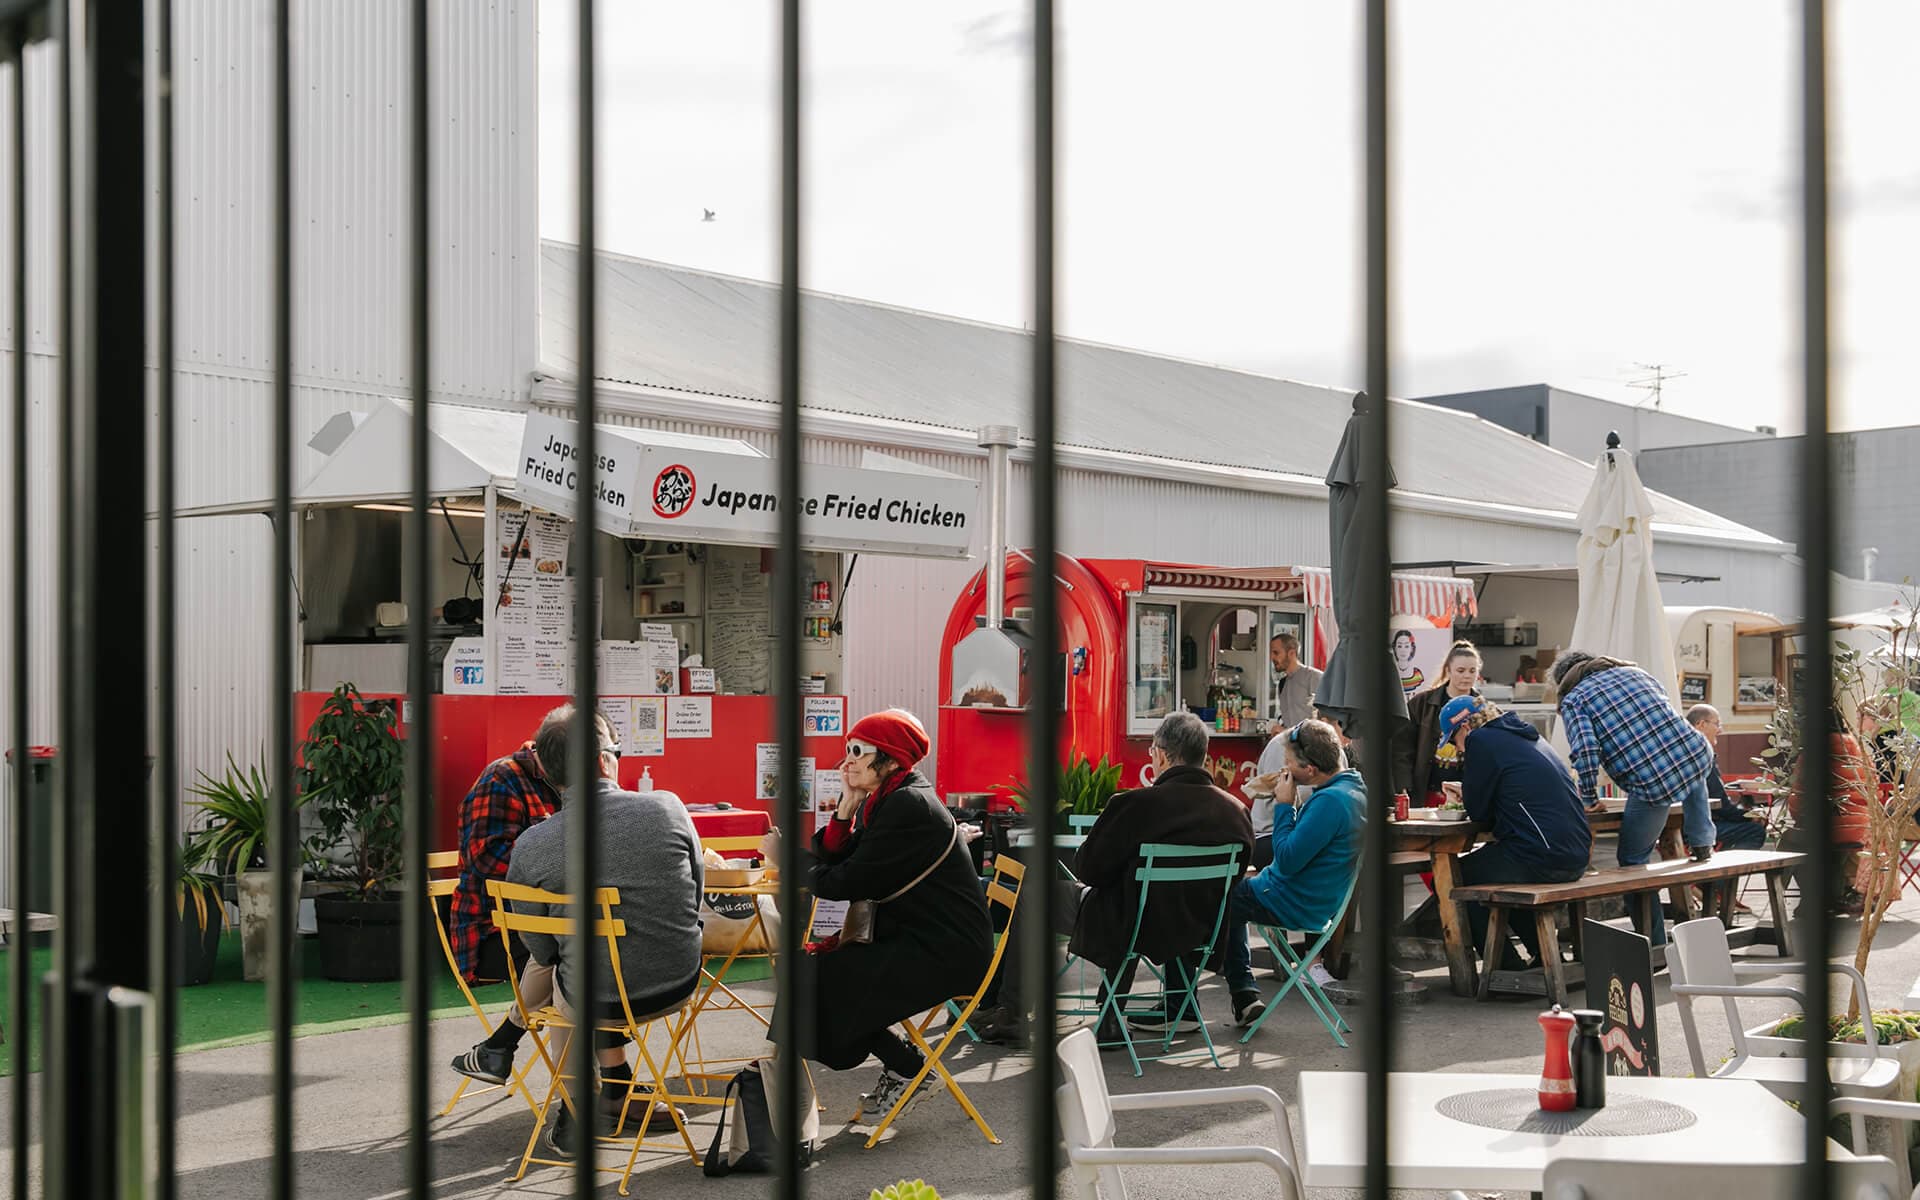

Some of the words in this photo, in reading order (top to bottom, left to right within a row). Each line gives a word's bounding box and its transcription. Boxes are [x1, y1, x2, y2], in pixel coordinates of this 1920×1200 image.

[544, 434, 616, 473] Japaese
[525, 457, 563, 486] Fried
[566, 470, 625, 507] Ccken
[702, 483, 817, 515] Japanse
[823, 494, 882, 521] Fried
[886, 500, 966, 528] Chicken
